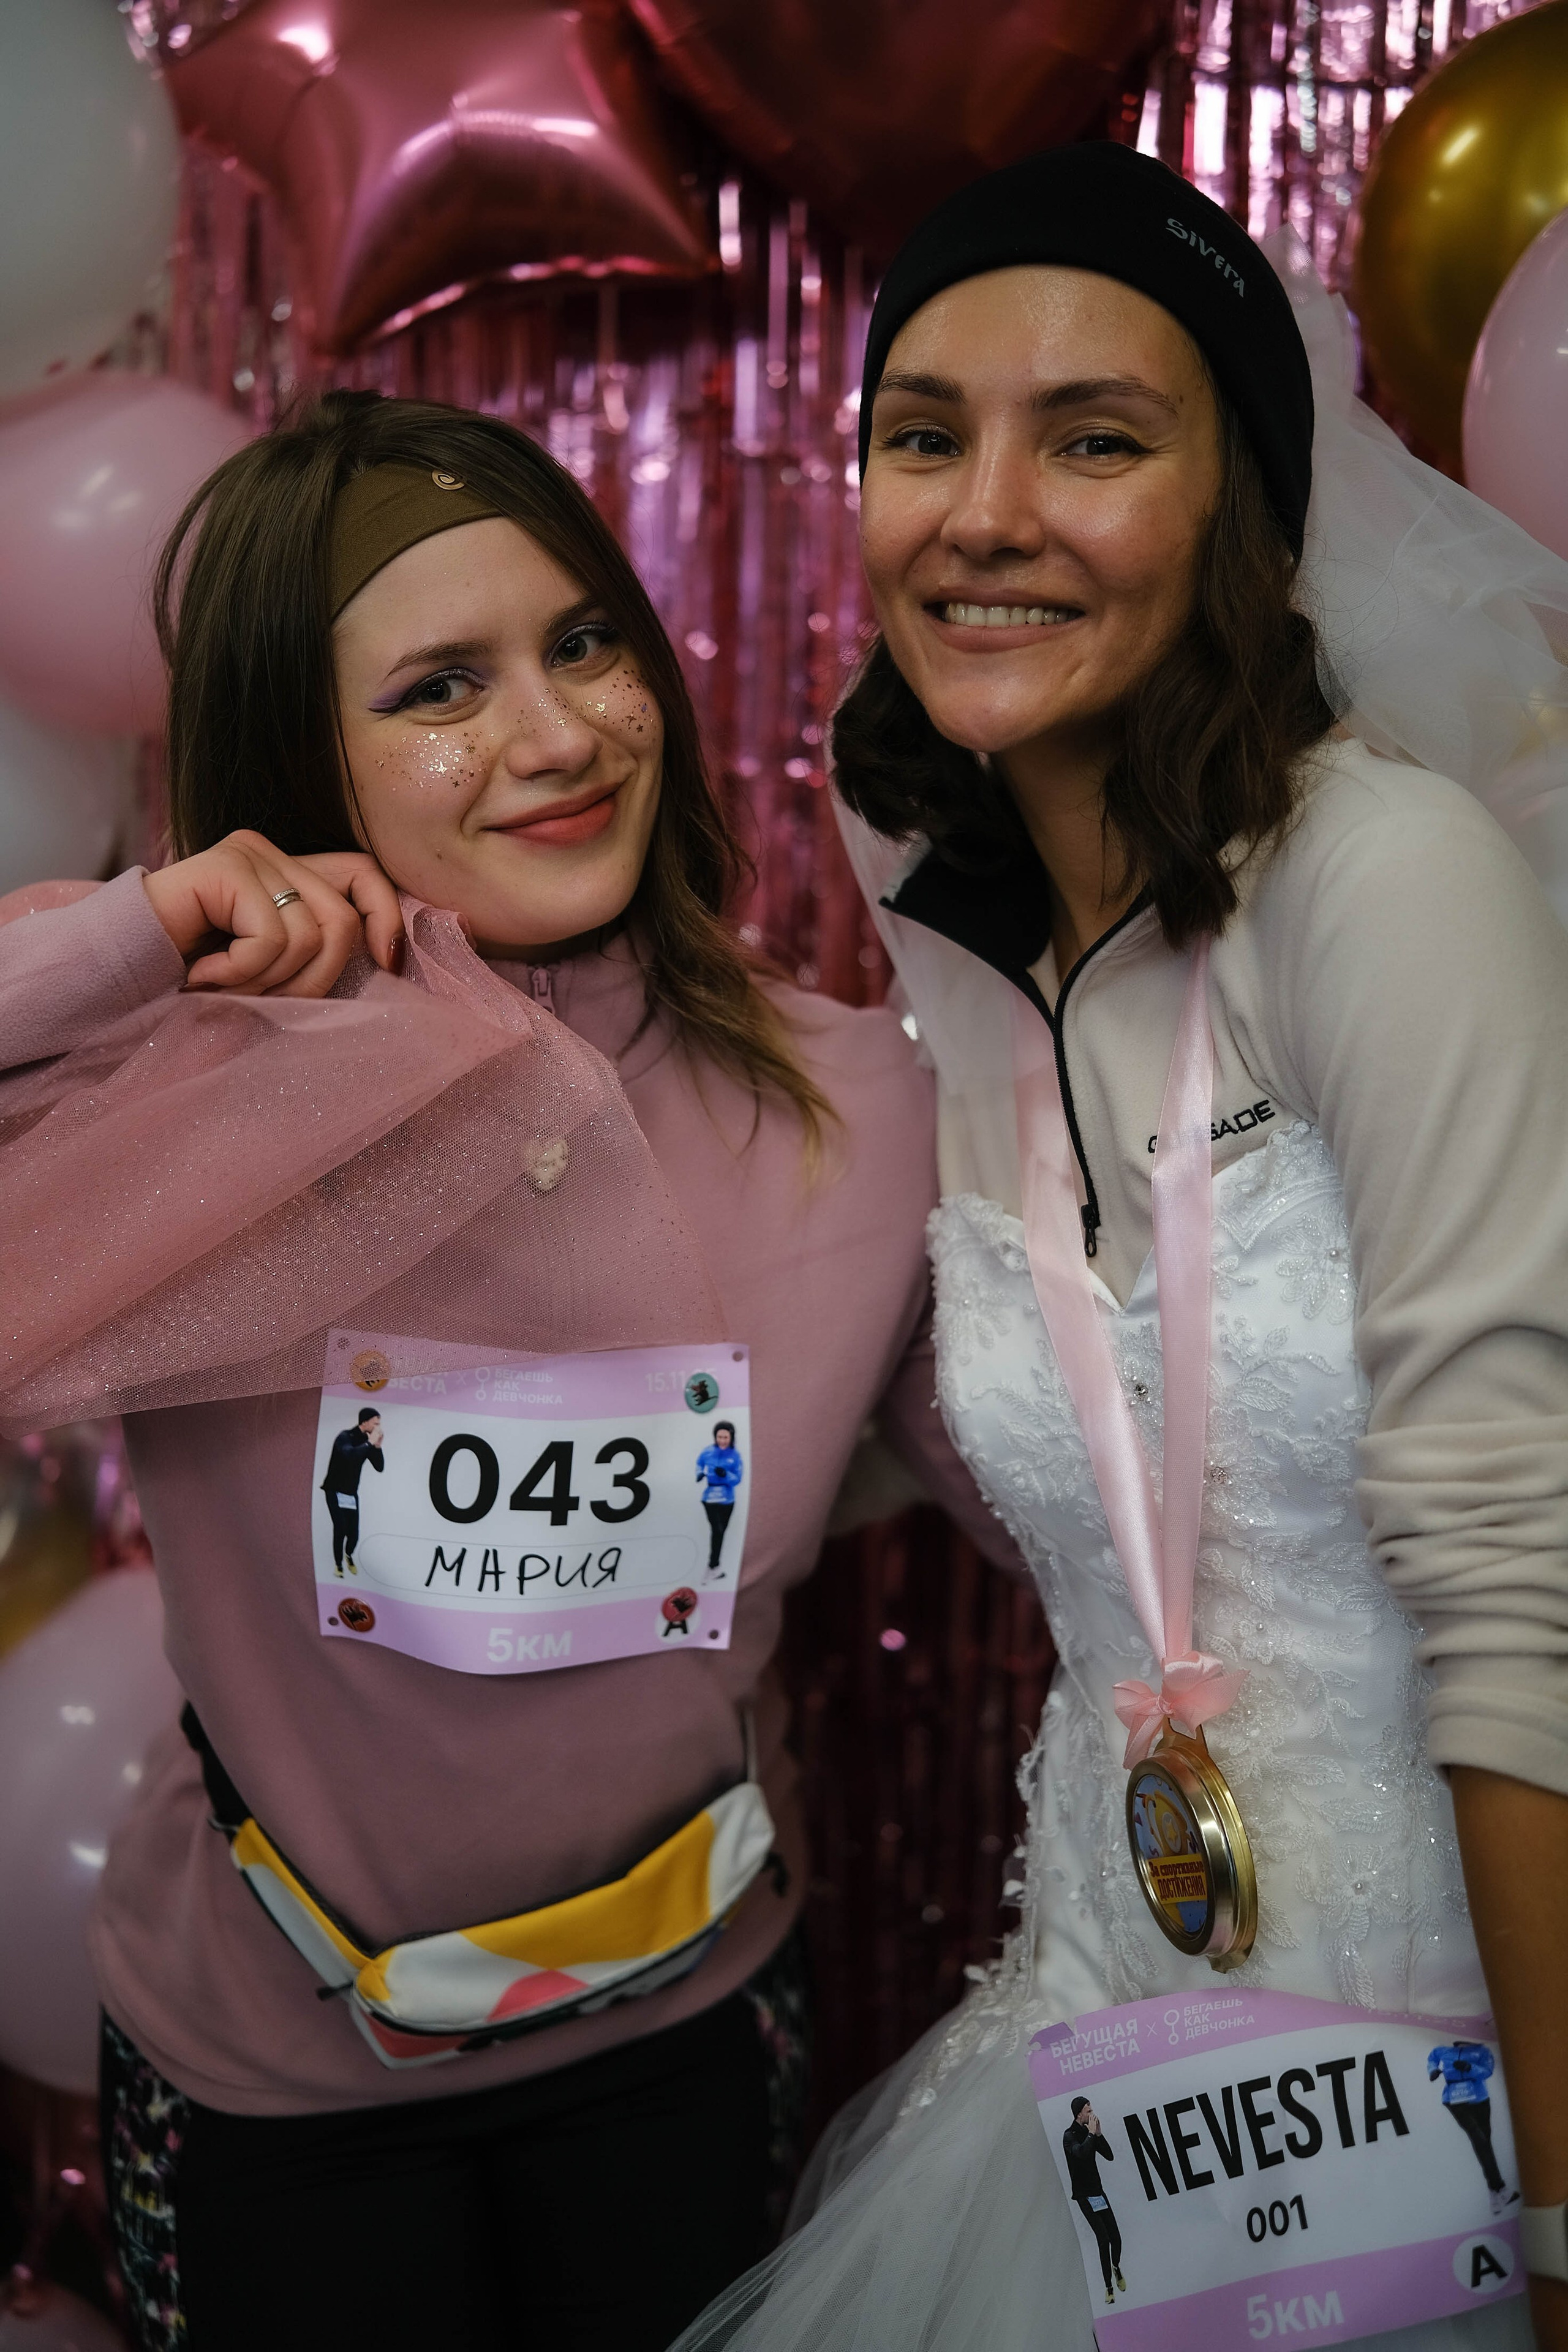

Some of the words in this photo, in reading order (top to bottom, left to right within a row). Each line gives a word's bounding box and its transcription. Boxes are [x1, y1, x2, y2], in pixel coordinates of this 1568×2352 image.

[494, 1368, 554, 1382] БЕГАЕШЬ
[494, 1380, 521, 1392] КАК
[492, 1390, 564, 1405] ДЕВЧОНКА
[429, 1433, 650, 1526] 043
[424, 1545, 622, 1595] МАРИЯ
[1148, 1861, 1159, 1877] За
[1157, 1875, 1206, 1901] ДОСТИЖЕНИЯ
[1183, 1998, 1243, 2017] БЕГАЕШЬ
[1183, 2012, 1210, 2027] КАК
[1049, 2018, 1139, 2059] БЕГУЩАЯ
[1184, 2014, 1256, 2041] ДЕВЧОНКА
[1058, 2038, 1141, 2076] НЕВЕСТА
[1122, 2049, 1411, 2202] NEVESTA
[1246, 2193, 1310, 2242] 001
